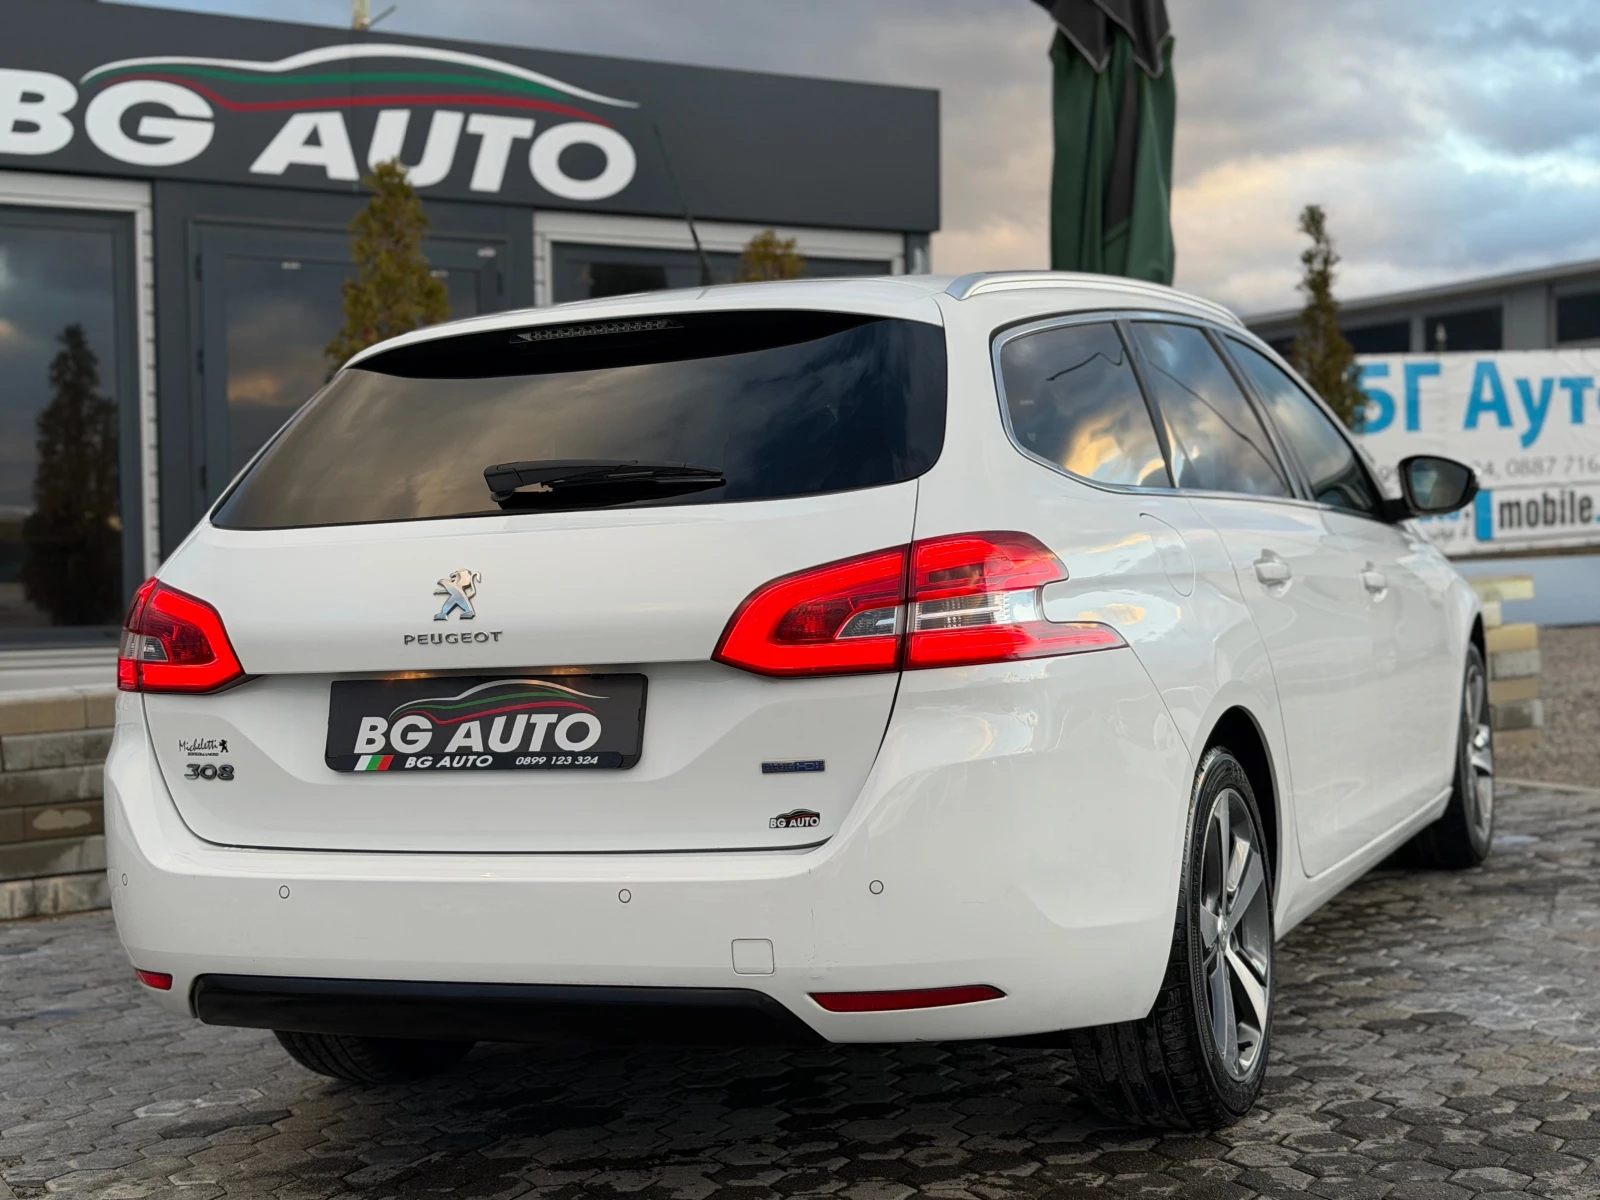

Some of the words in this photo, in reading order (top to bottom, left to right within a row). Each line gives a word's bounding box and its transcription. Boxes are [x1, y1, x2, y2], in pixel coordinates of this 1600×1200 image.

[0, 67, 215, 167] BG
[249, 108, 637, 201] AUTO
[1463, 360, 1600, 449] Аут
[403, 630, 503, 646] PEUGEOT
[354, 714, 433, 754] BG
[443, 712, 602, 753] AUTO
[404, 755, 433, 769] BG
[438, 754, 493, 768] AUTO
[515, 755, 547, 766] 0899
[550, 755, 572, 766] 123
[575, 755, 599, 765] 324
[184, 764, 235, 780] 308
[770, 818, 786, 828] BG
[789, 816, 820, 827] AUTO
